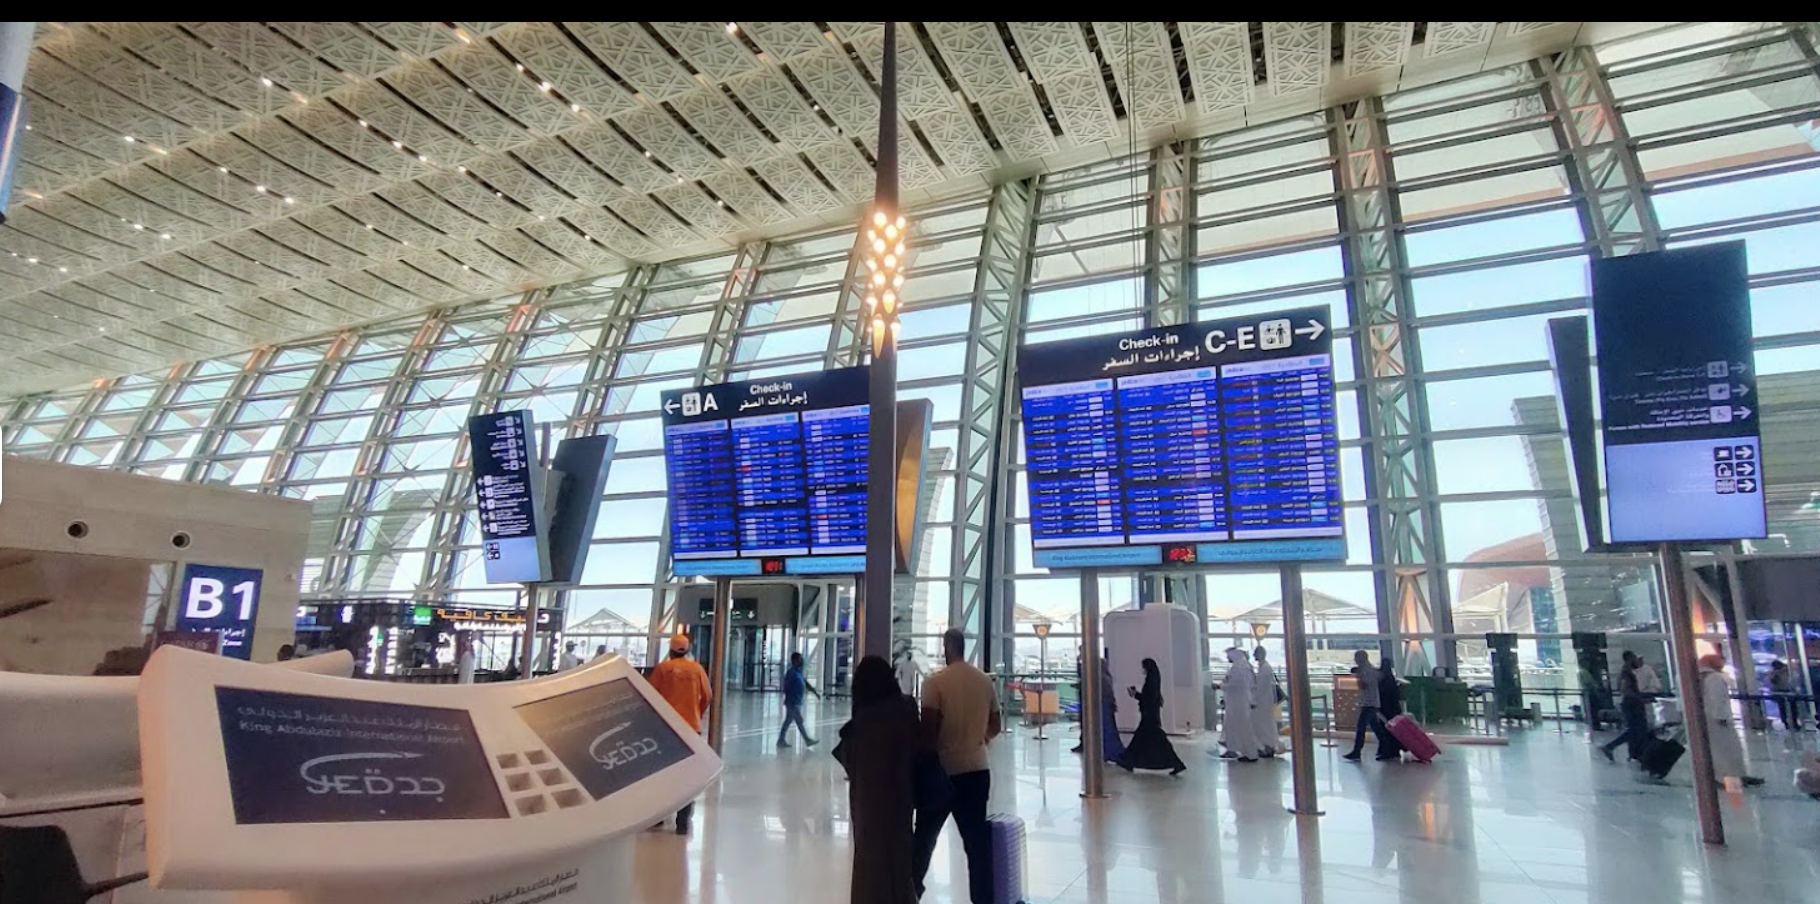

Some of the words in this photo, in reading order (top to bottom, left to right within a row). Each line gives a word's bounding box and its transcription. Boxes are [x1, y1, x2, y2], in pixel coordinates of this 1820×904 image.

[1119, 333, 1179, 350] Check-in
[1205, 326, 1256, 354] C-E
[1102, 352, 1139, 371] السفر
[1144, 345, 1200, 363] إجراءات
[749, 381, 793, 396] Check-in
[703, 392, 719, 412] A
[738, 396, 765, 412] السفر
[767, 391, 808, 406] إجراءات
[185, 577, 256, 621] B1
[240, 720, 273, 734] King
[277, 724, 341, 737] Abdulaziz
[345, 728, 423, 742] International
